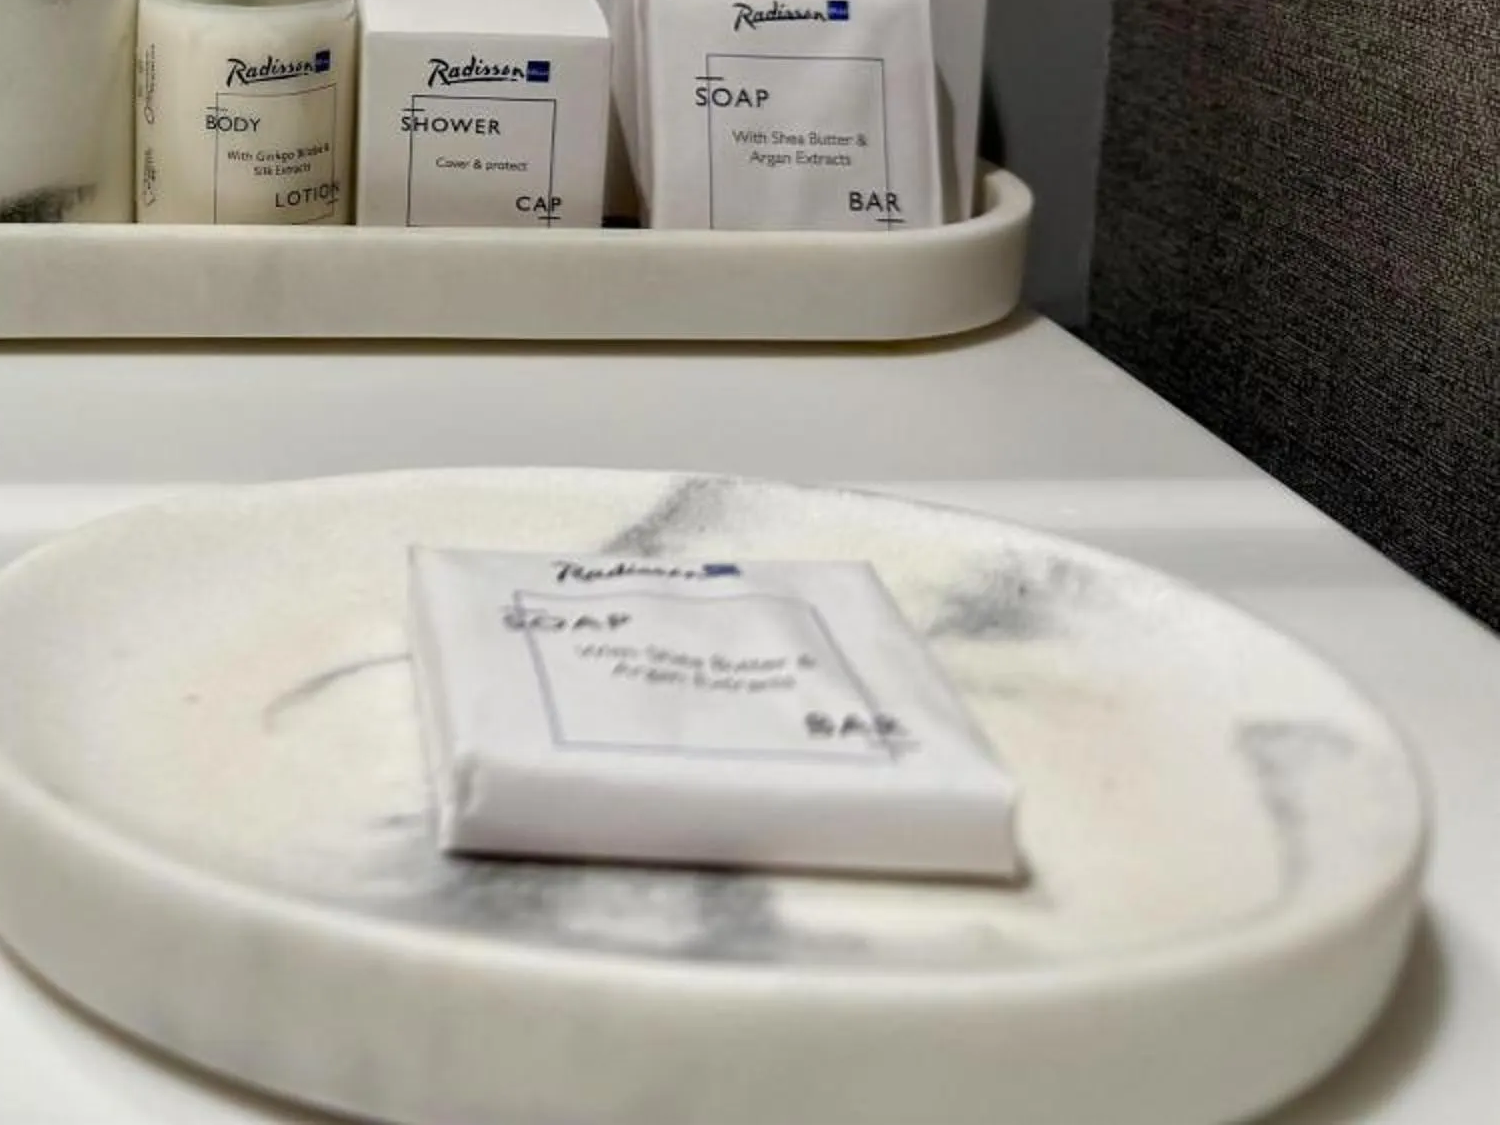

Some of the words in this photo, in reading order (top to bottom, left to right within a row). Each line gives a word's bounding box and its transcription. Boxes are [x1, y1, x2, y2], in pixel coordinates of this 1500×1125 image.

[732, 1, 827, 32] Radisson
[226, 54, 314, 88] Radisson
[428, 55, 524, 88] Radisson
[695, 87, 771, 108] SOAP
[205, 114, 261, 132] BODY
[401, 116, 501, 135] SHOWER
[732, 130, 767, 145] With
[771, 131, 805, 146] Shea
[809, 132, 852, 147] Butter
[855, 133, 869, 148] &
[227, 150, 253, 162] With
[436, 156, 469, 170] Cover
[472, 158, 483, 171] &
[485, 159, 528, 173] protect
[750, 150, 791, 166] Argan
[796, 151, 852, 166] Extracts
[275, 183, 340, 208] LOTION
[515, 196, 562, 212] CAP
[849, 190, 902, 213] BAR
[551, 560, 698, 583] Radisson
[502, 612, 632, 633] SOAP
[802, 709, 912, 740] BAR
